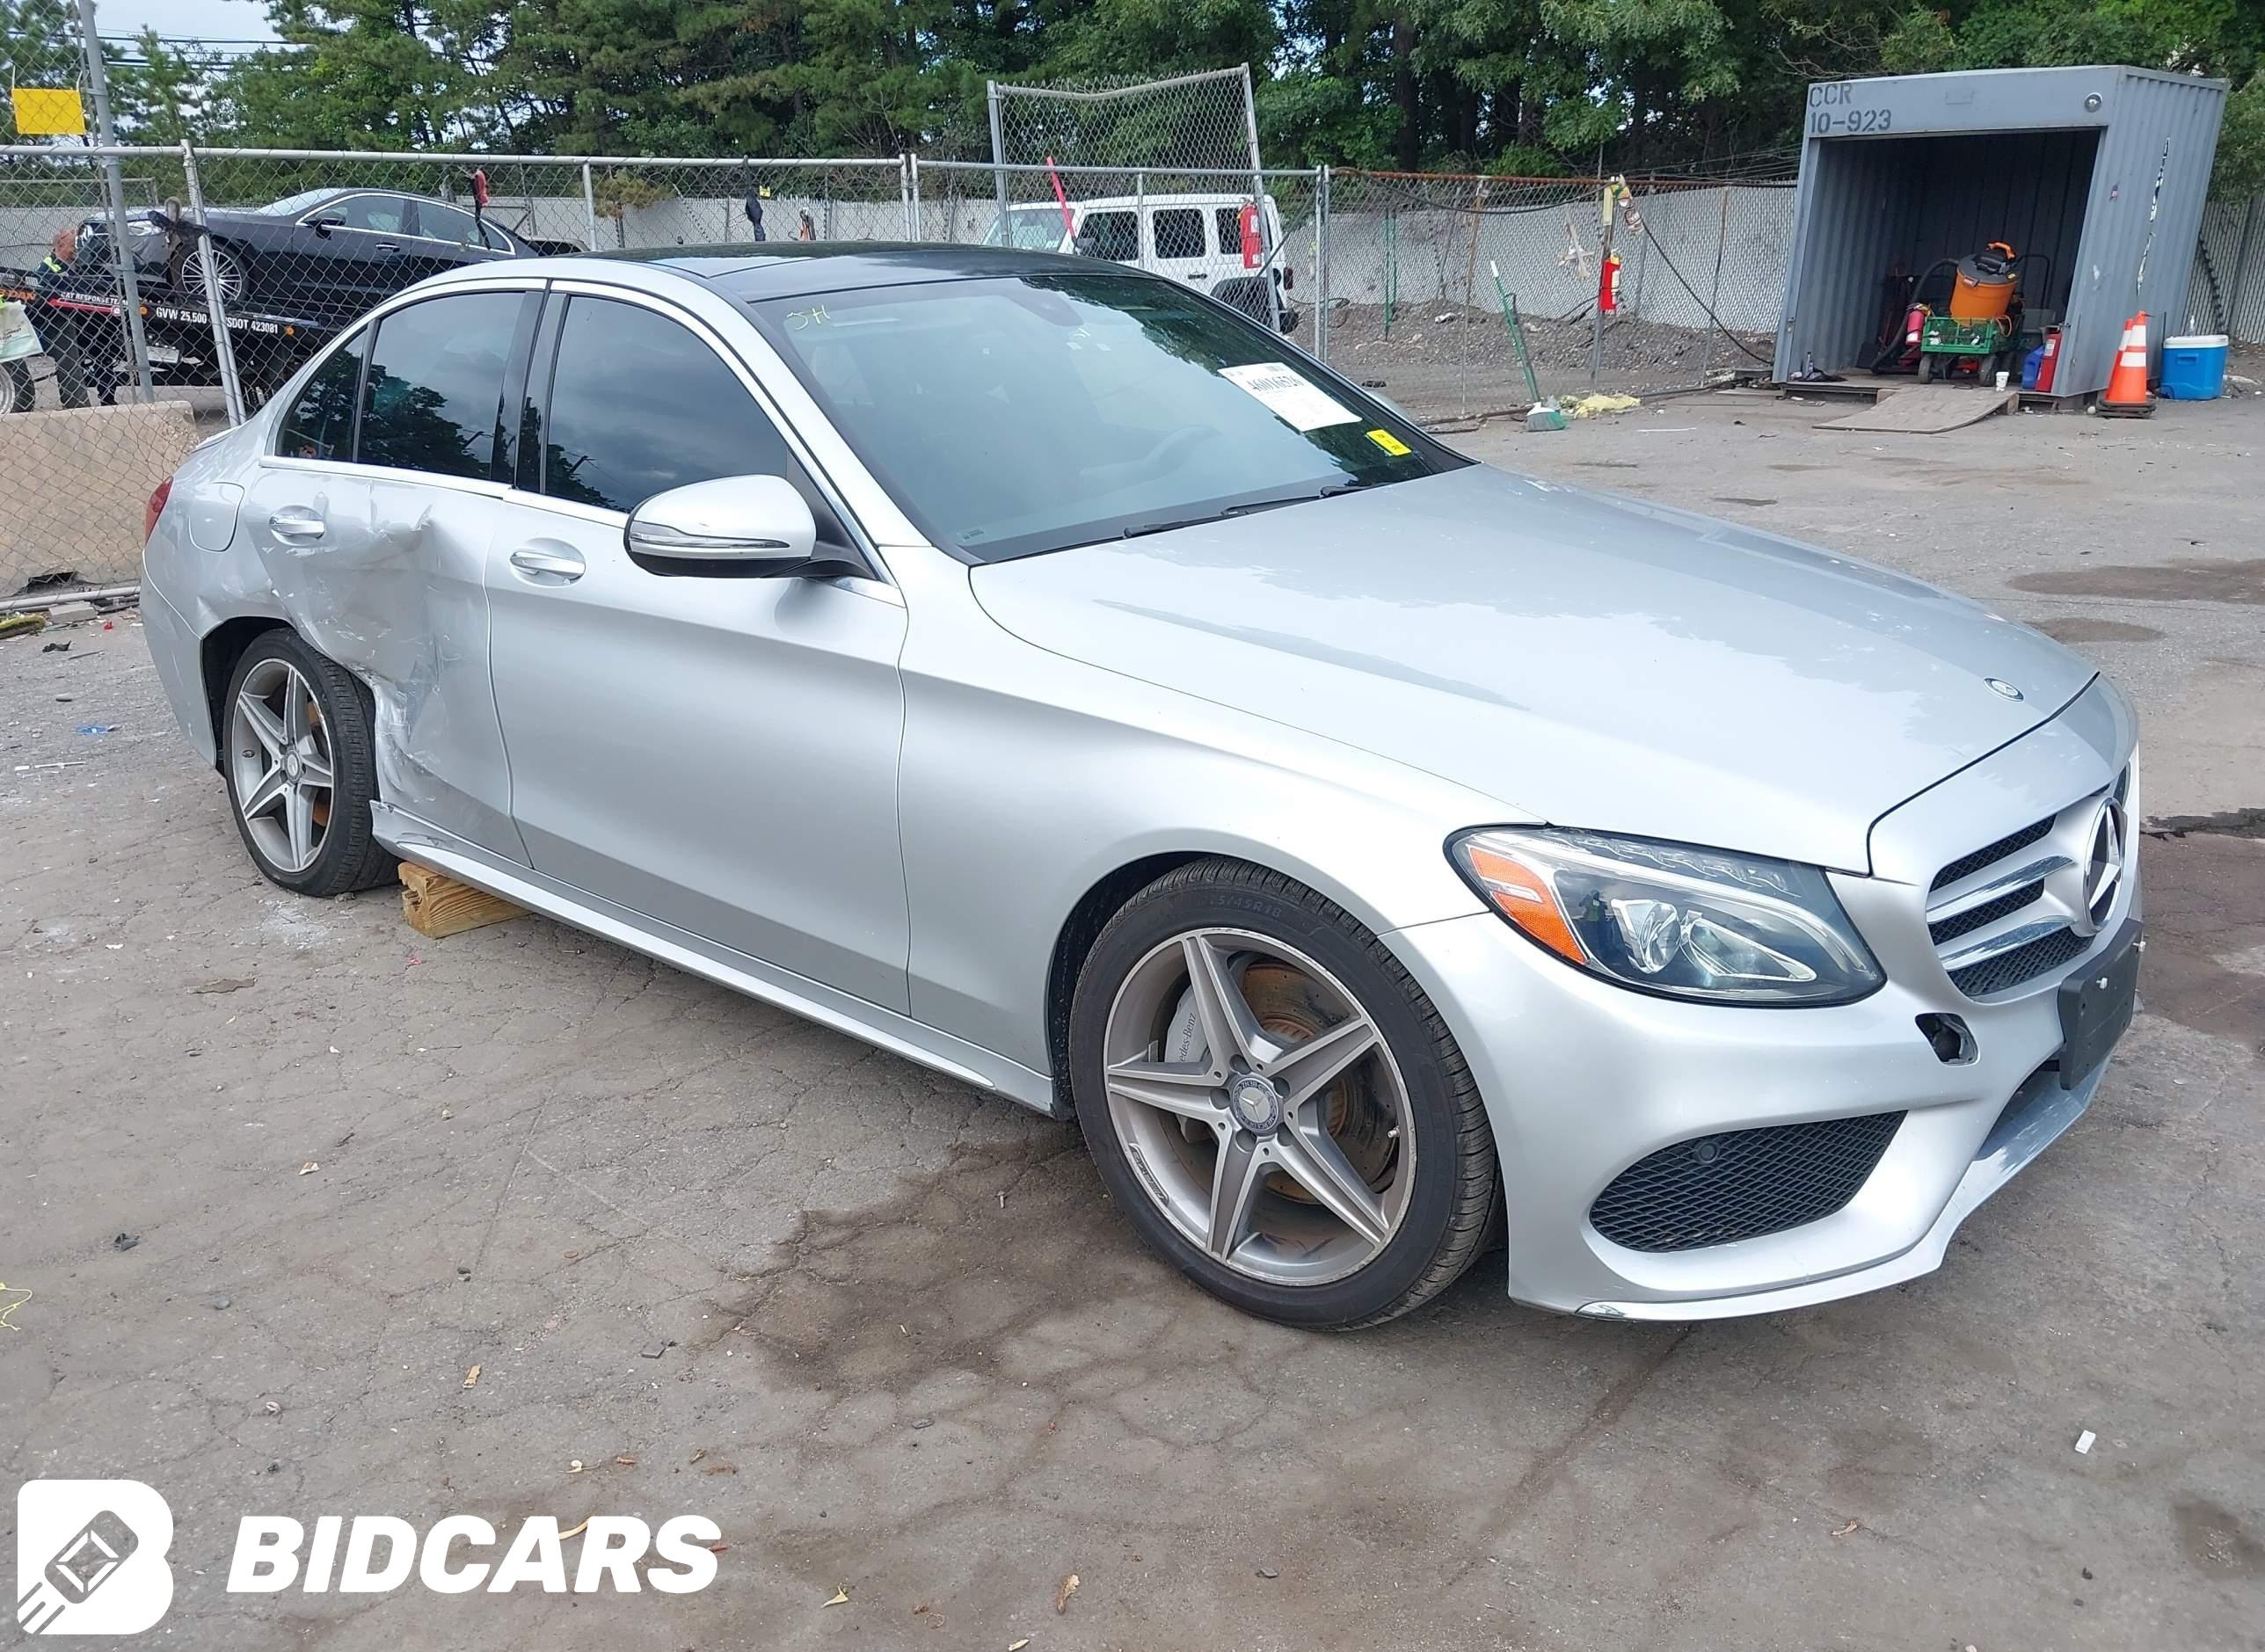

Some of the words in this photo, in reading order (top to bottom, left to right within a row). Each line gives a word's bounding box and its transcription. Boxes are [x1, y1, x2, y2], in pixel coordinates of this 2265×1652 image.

[1809, 83, 1852, 107] CCR
[1811, 109, 1891, 134] 10-923
[156, 307, 178, 320] GVW
[225, 317, 249, 331] SDOT
[251, 320, 279, 334] 423081
[1198, 895, 1282, 918] 5/45R18
